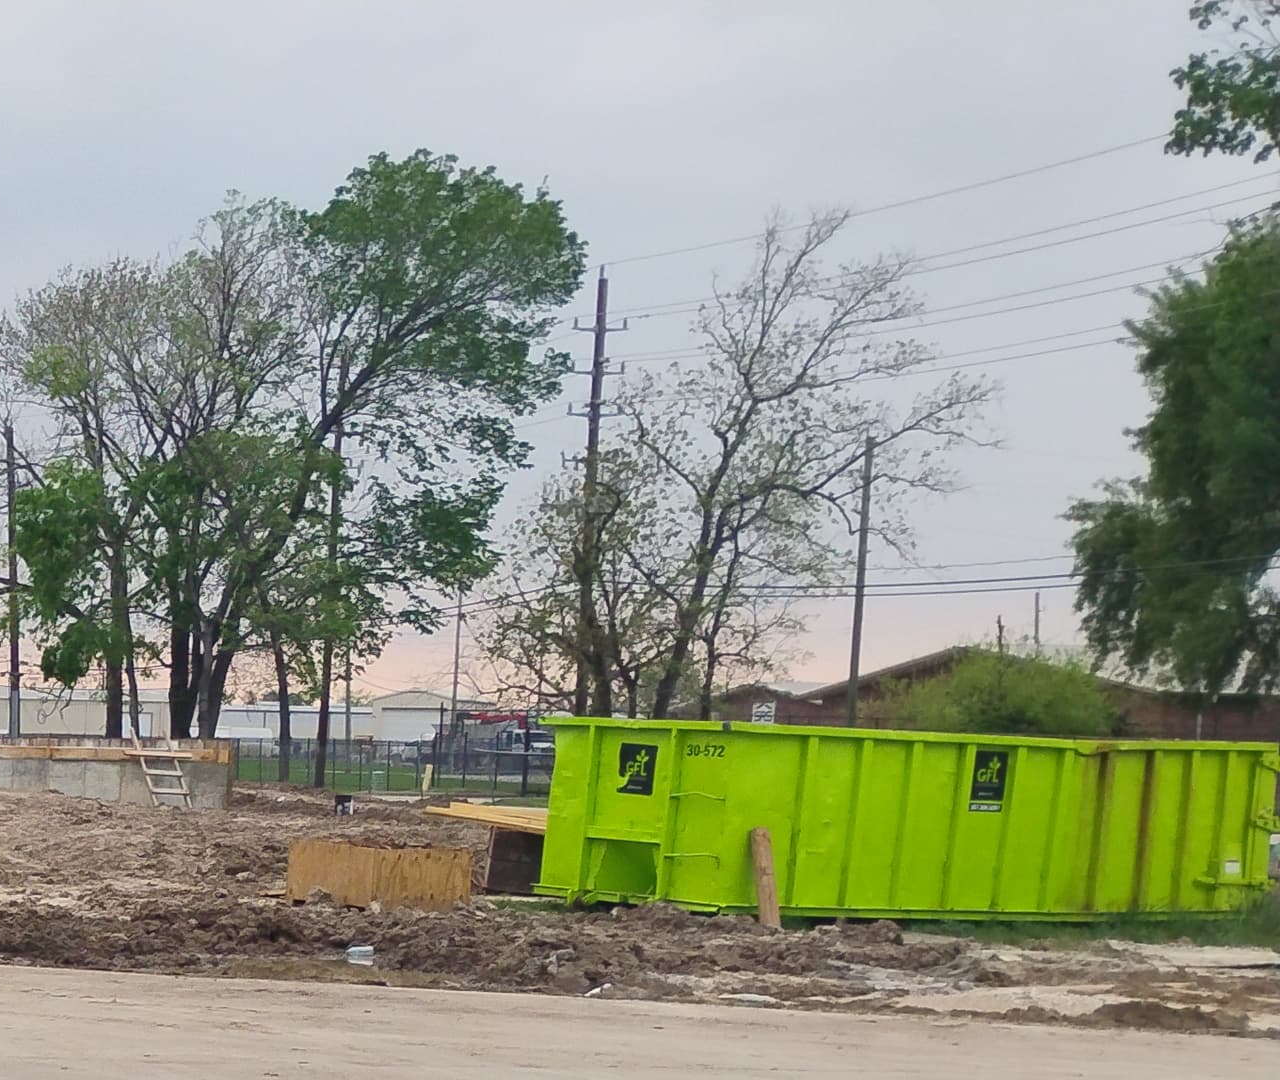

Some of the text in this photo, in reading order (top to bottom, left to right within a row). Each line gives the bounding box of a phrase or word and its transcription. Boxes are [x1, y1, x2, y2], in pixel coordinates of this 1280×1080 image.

[686, 743, 726, 758] 30-572
[626, 760, 648, 777] GFL
[977, 768, 1000, 784] GFL
